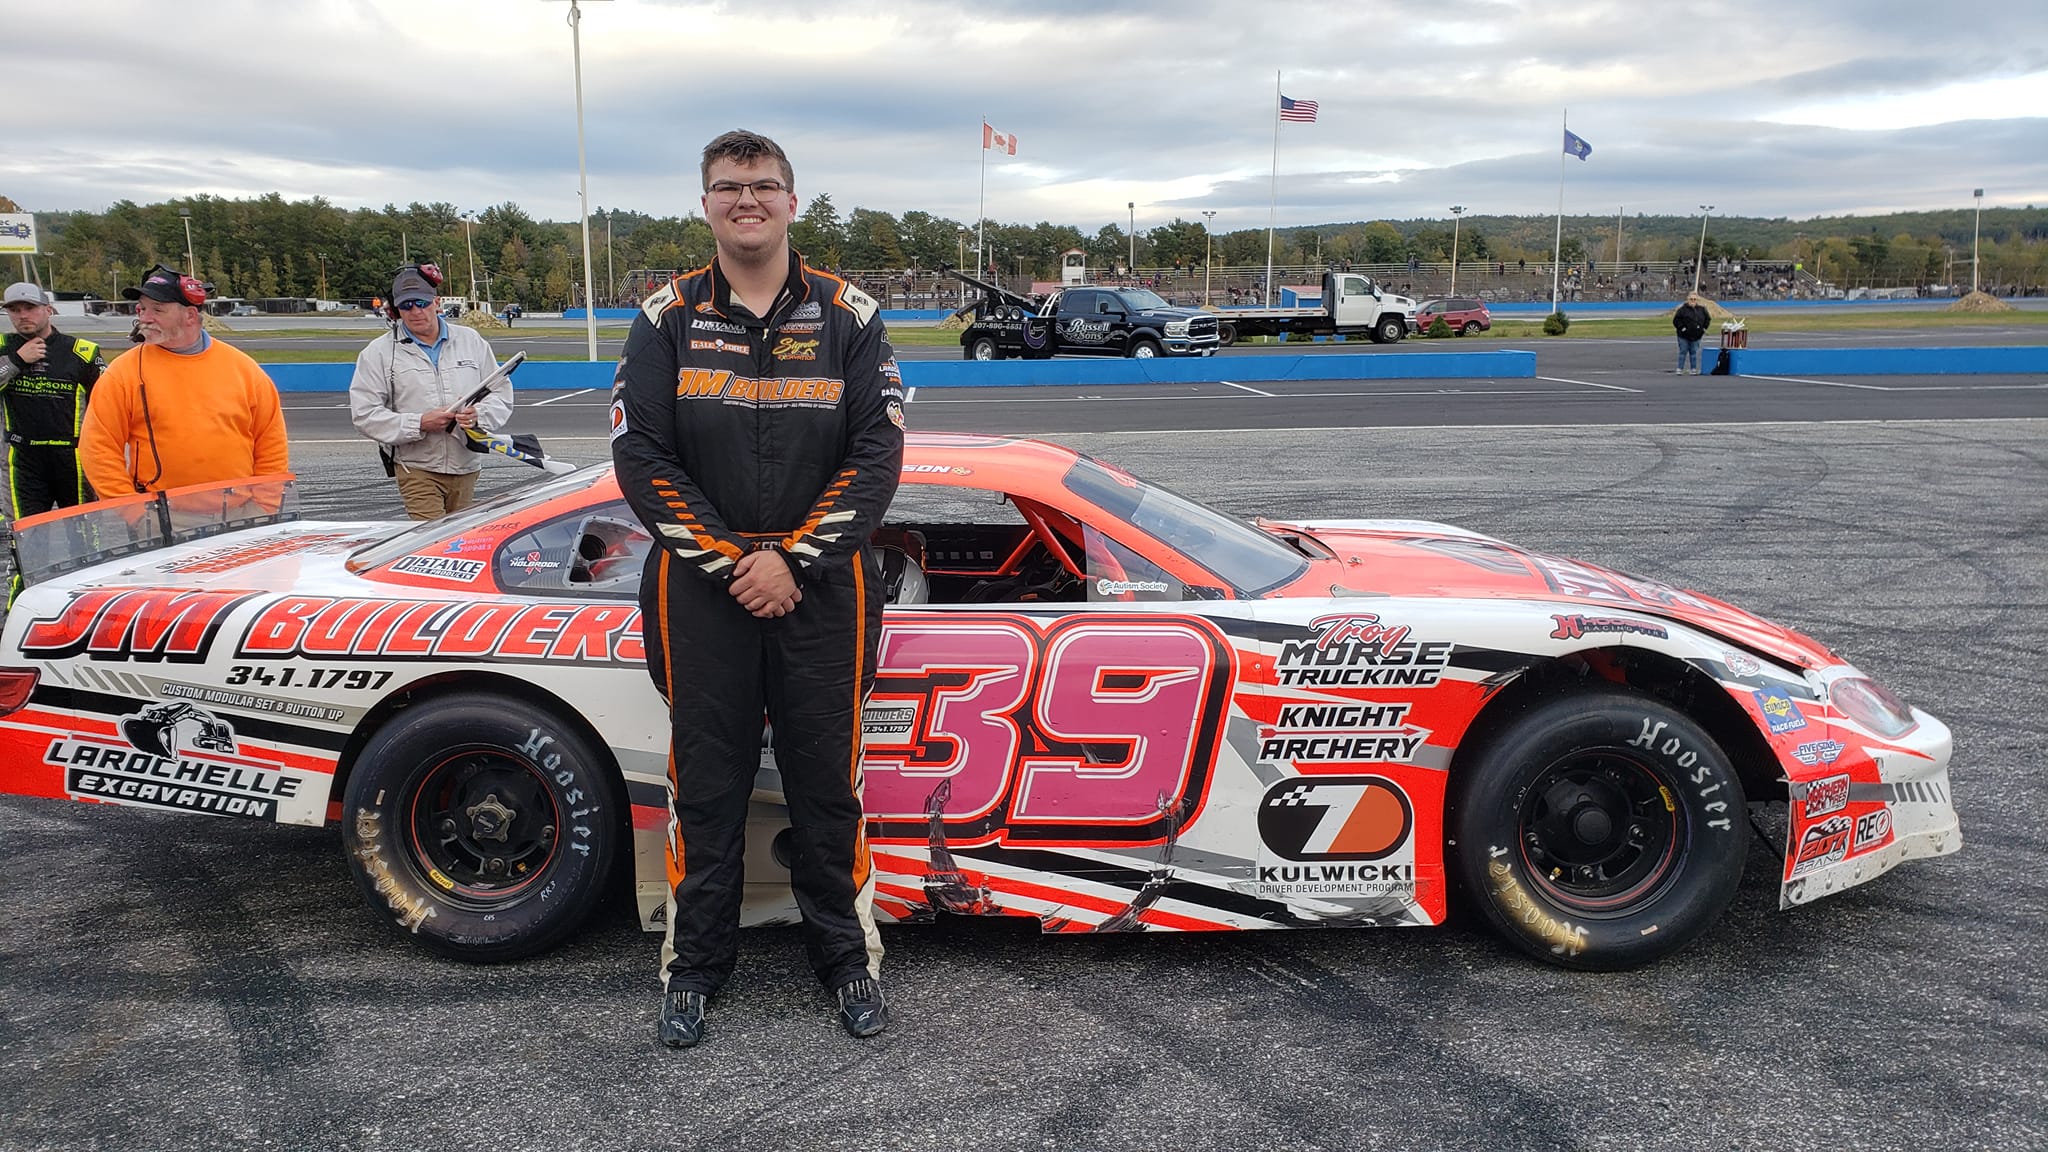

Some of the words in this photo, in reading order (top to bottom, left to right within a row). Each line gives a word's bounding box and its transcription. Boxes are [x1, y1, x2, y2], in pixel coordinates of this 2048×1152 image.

[677, 369, 731, 398] JM
[728, 378, 843, 402] BUILDERS
[392, 556, 485, 575] DISTANCE
[1140, 582, 1167, 591] Society
[19, 588, 262, 662] JM
[1310, 613, 1410, 656] Troy
[1583, 625, 1634, 633] RACING
[1278, 642, 1451, 666] MORSE
[226, 666, 394, 691] 341.1797
[1281, 669, 1441, 685] TRUCKING
[160, 683, 204, 700] CUSTOM
[205, 691, 254, 708] MODULAR
[255, 698, 275, 711] SET
[285, 702, 325, 718] BUTTON
[328, 709, 344, 721] UP
[1765, 700, 1790, 714] SUNOCO
[863, 617, 1222, 832] 39
[864, 709, 913, 721] UILDERS
[1279, 706, 1407, 727] KNIGHT
[1788, 718, 1806, 730] FUELS
[1260, 737, 1421, 760] ARCHERY
[1799, 743, 1817, 756] FIVE
[1817, 740, 1837, 751] STAR
[47, 742, 302, 798] LAROCHELLE
[1626, 717, 1732, 832] Hoosier
[77, 774, 268, 817] EXCAVATION
[515, 727, 600, 857] Hoosier
[1800, 830, 1849, 862] 207
[353, 807, 438, 934] Hoosier
[1259, 865, 1412, 882] KULWICKI
[1793, 850, 1844, 875] BRAND
[1259, 885, 1293, 893] DRIVER
[1296, 884, 1364, 893] DEVELOPMENT
[1366, 882, 1414, 892] PROGRAM
[1488, 846, 1590, 957] Hoosier
